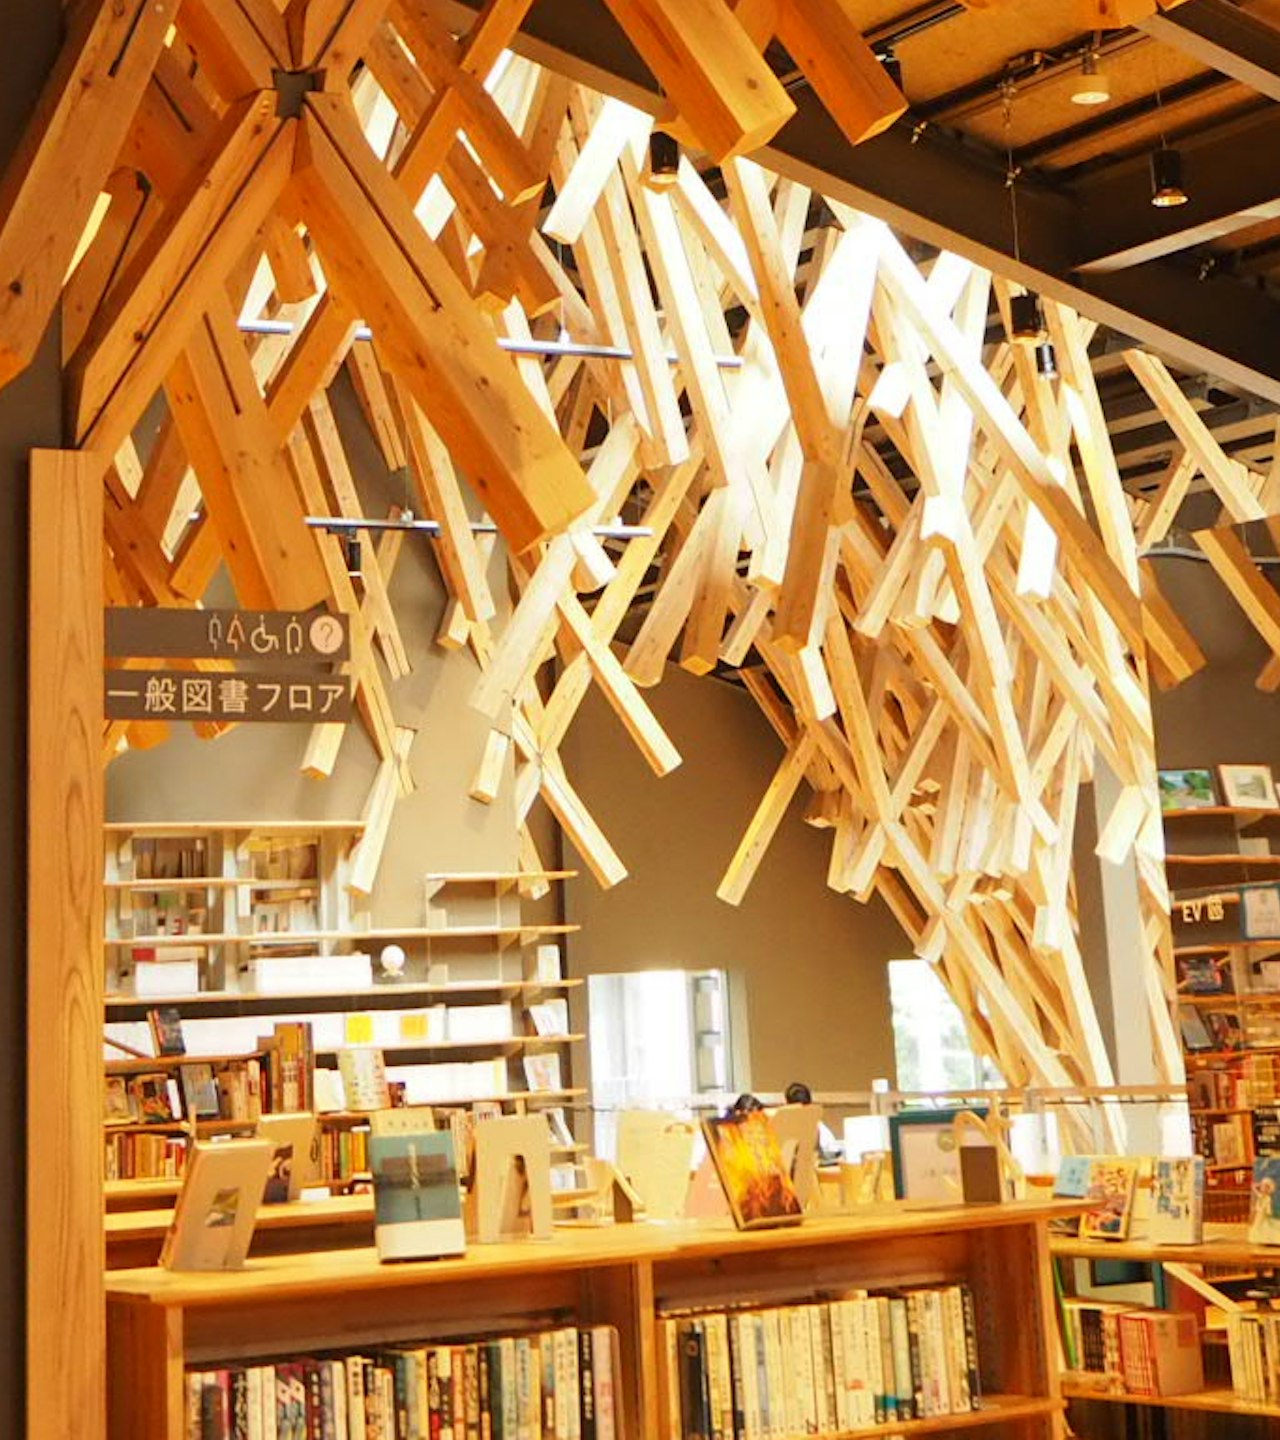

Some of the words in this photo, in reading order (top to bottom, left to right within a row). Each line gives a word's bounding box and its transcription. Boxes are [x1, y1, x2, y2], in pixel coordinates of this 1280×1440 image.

[107, 676, 345, 713] 一般図書フロア
[1182, 901, 1202, 923] EV
